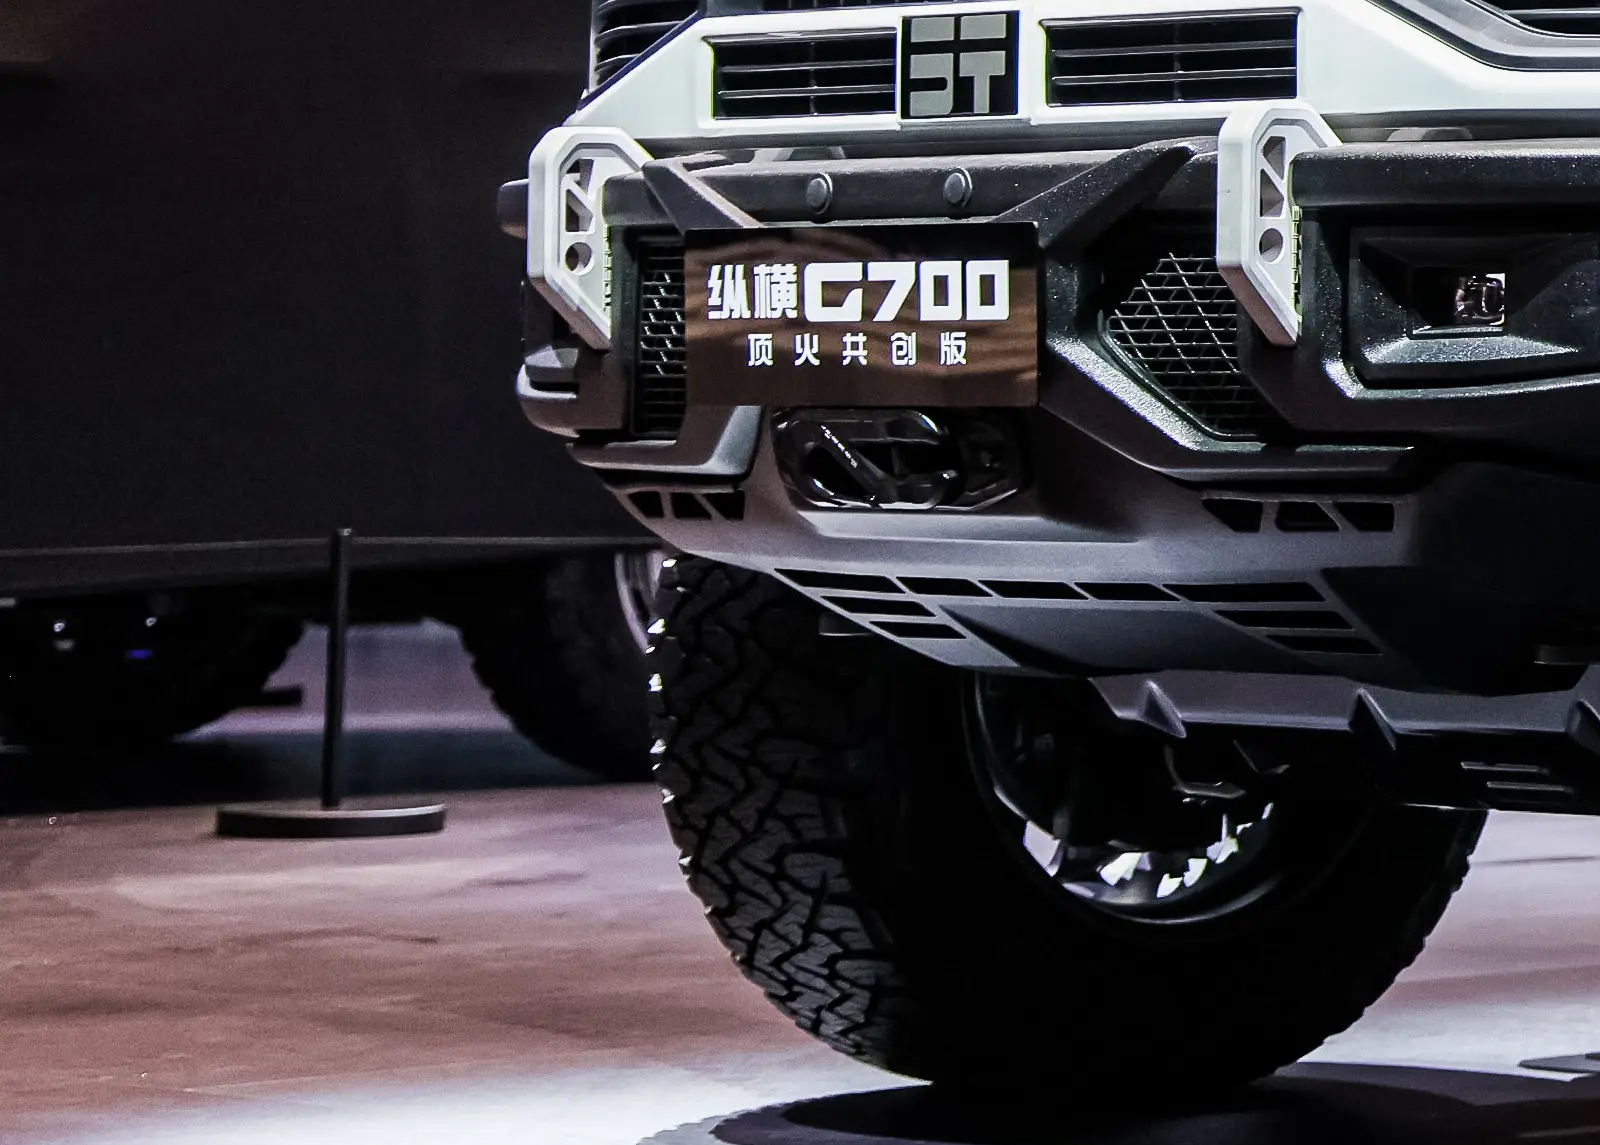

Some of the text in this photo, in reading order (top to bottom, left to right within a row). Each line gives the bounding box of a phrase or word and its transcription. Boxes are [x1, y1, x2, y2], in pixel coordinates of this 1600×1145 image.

[746, 330, 968, 367] 顶火共创版
